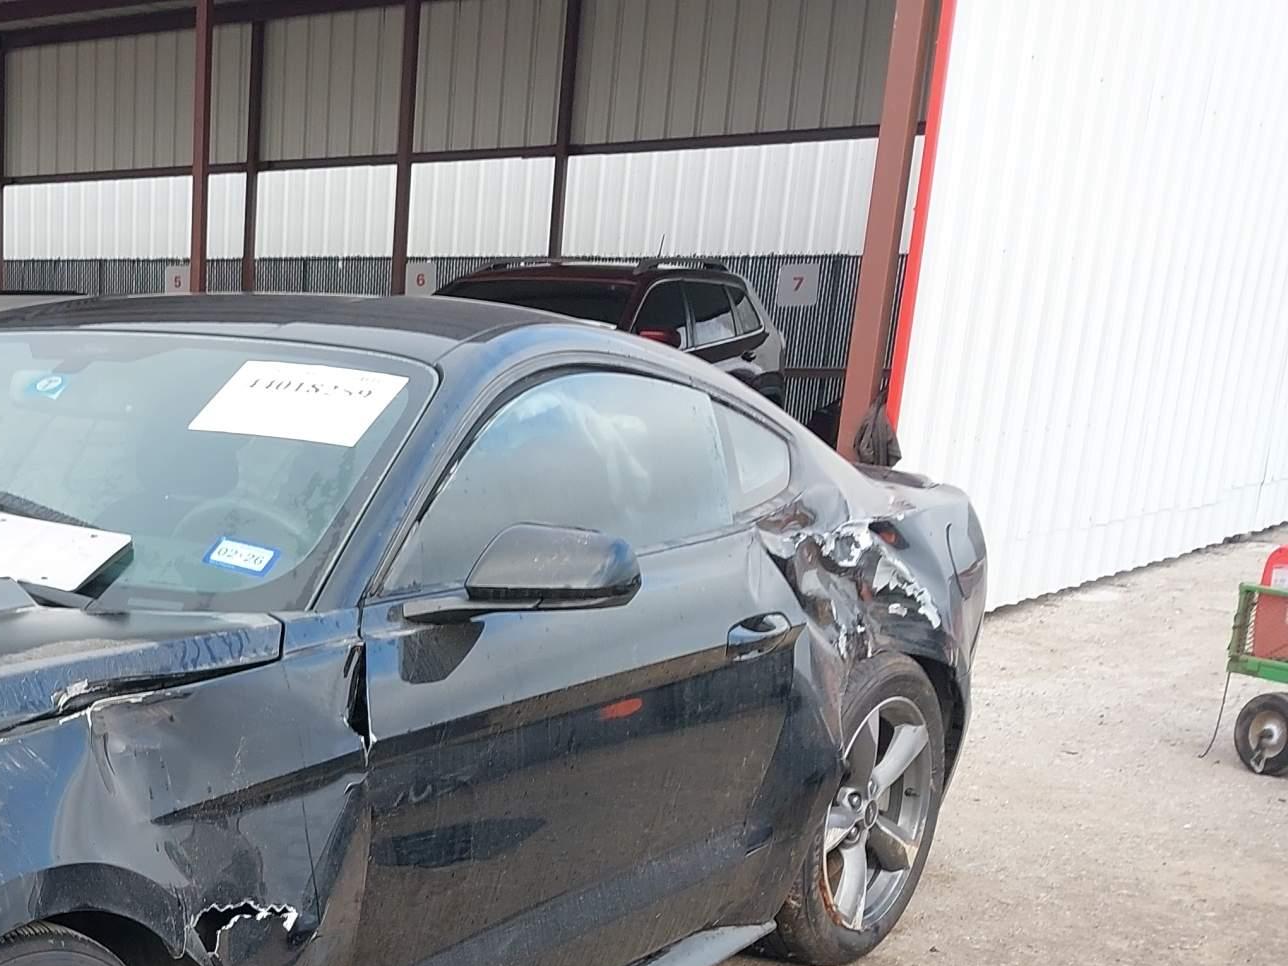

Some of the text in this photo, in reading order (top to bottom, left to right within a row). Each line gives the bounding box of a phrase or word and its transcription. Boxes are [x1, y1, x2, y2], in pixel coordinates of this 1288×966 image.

[174, 275, 182, 289] 5
[416, 273, 425, 287] 6
[793, 276, 804, 291] 7
